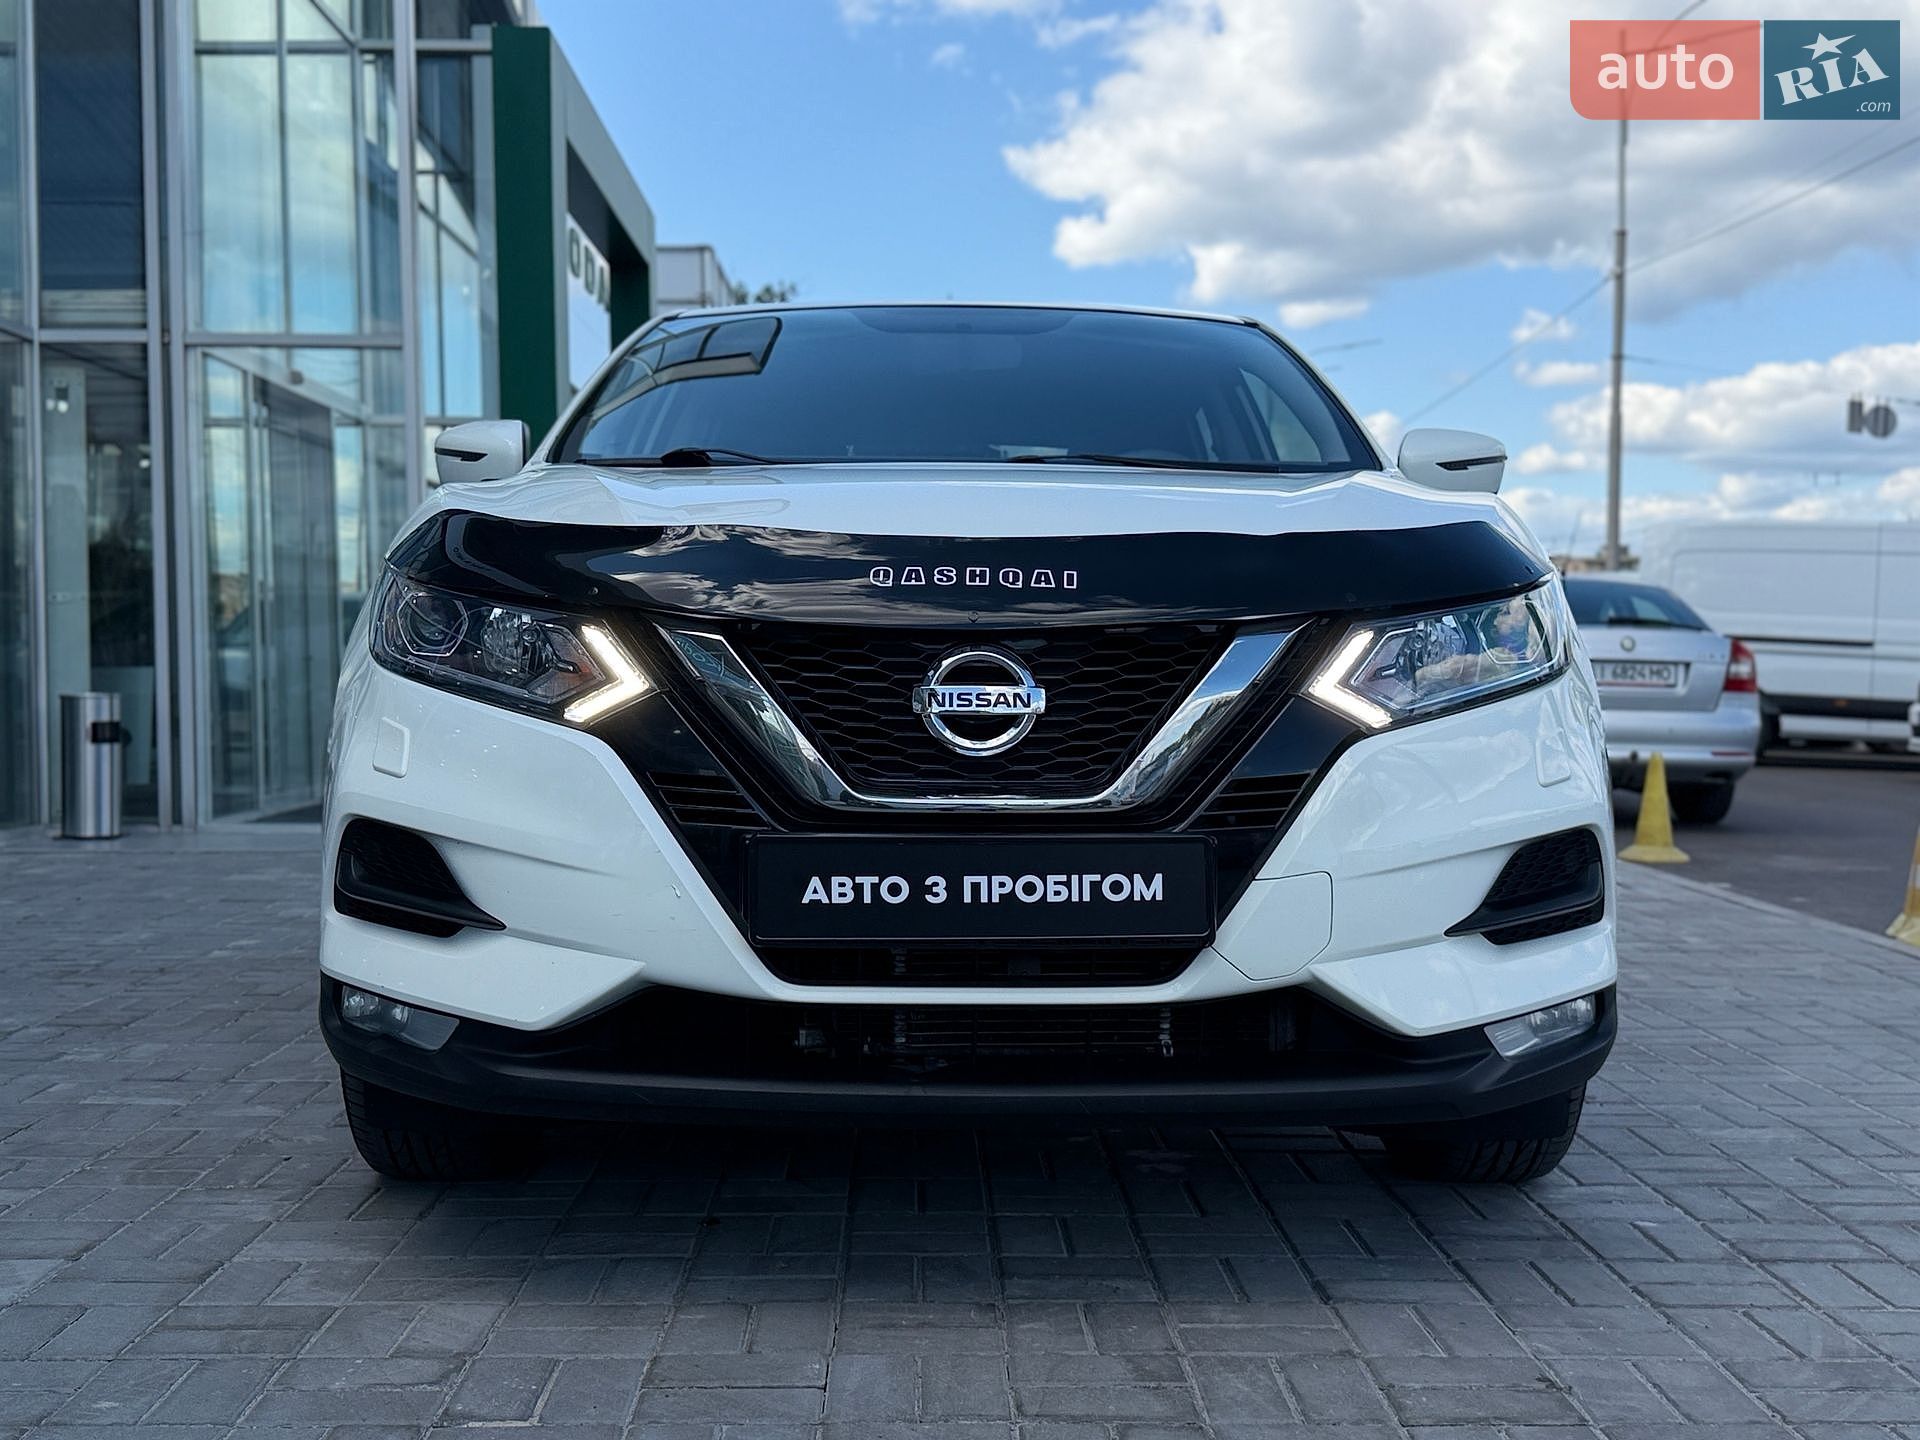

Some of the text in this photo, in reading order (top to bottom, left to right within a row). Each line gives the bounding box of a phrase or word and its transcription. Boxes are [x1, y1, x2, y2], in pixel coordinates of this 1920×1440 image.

[869, 566, 1078, 589] QASHQAI
[927, 692, 1031, 708] NISSAN
[801, 875, 910, 904] АВТО
[963, 873, 1164, 903] ПРОБІГОМ
